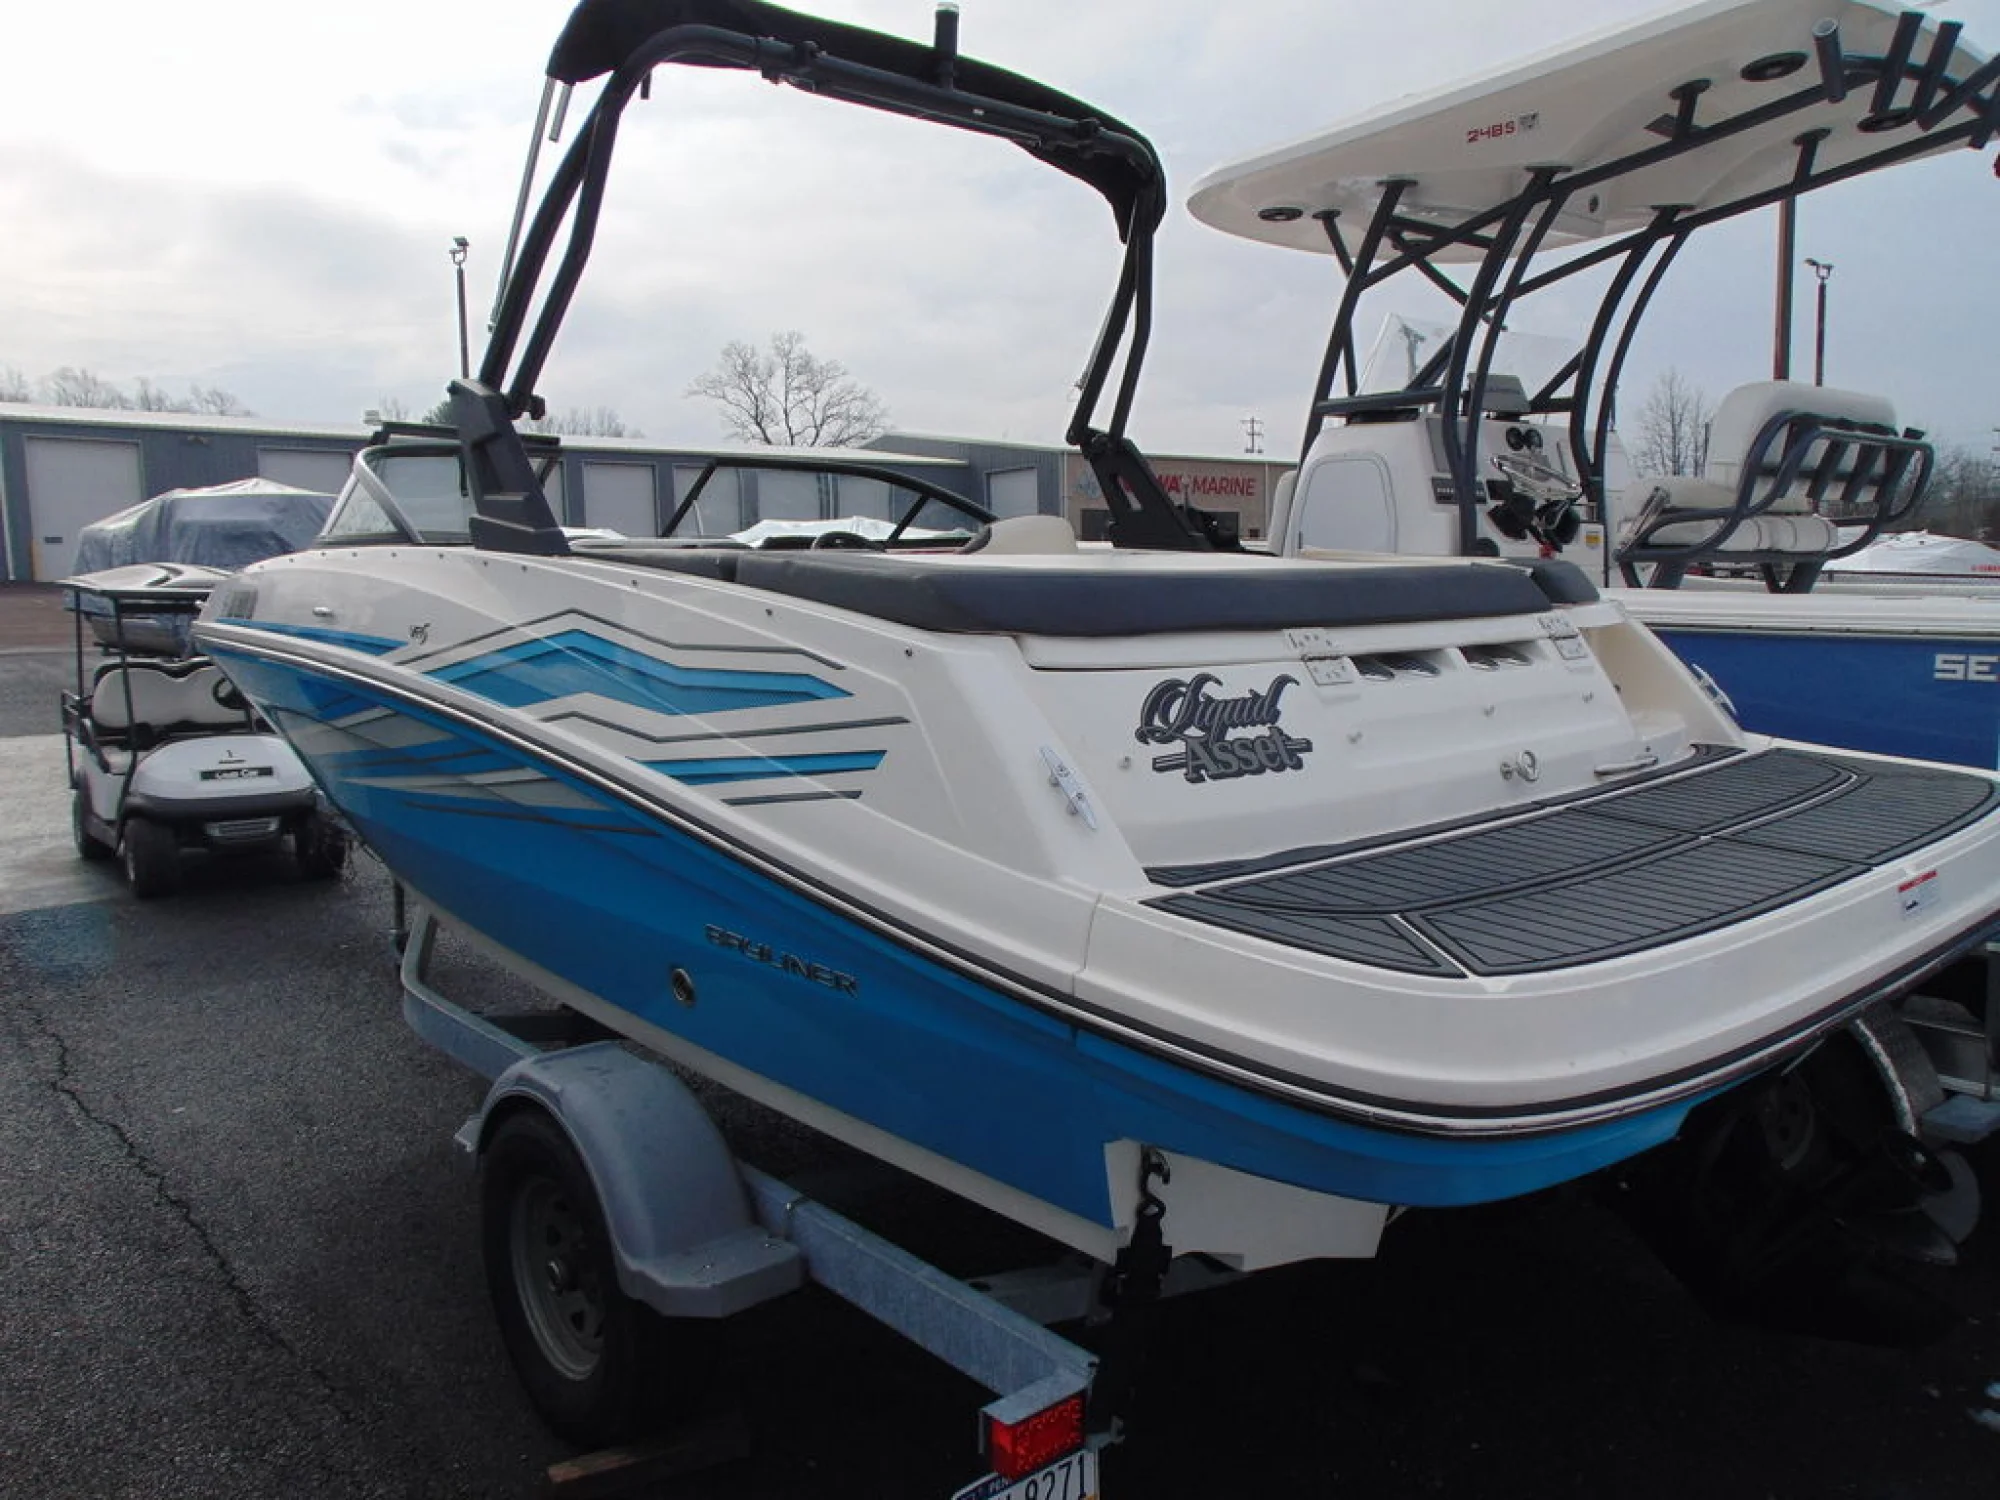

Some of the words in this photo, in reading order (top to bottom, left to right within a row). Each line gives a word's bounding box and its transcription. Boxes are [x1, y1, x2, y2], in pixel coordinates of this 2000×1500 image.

[1192, 475, 1256, 496] MARINE
[1135, 672, 1300, 744] Liquid
[1184, 726, 1304, 784] Asset
